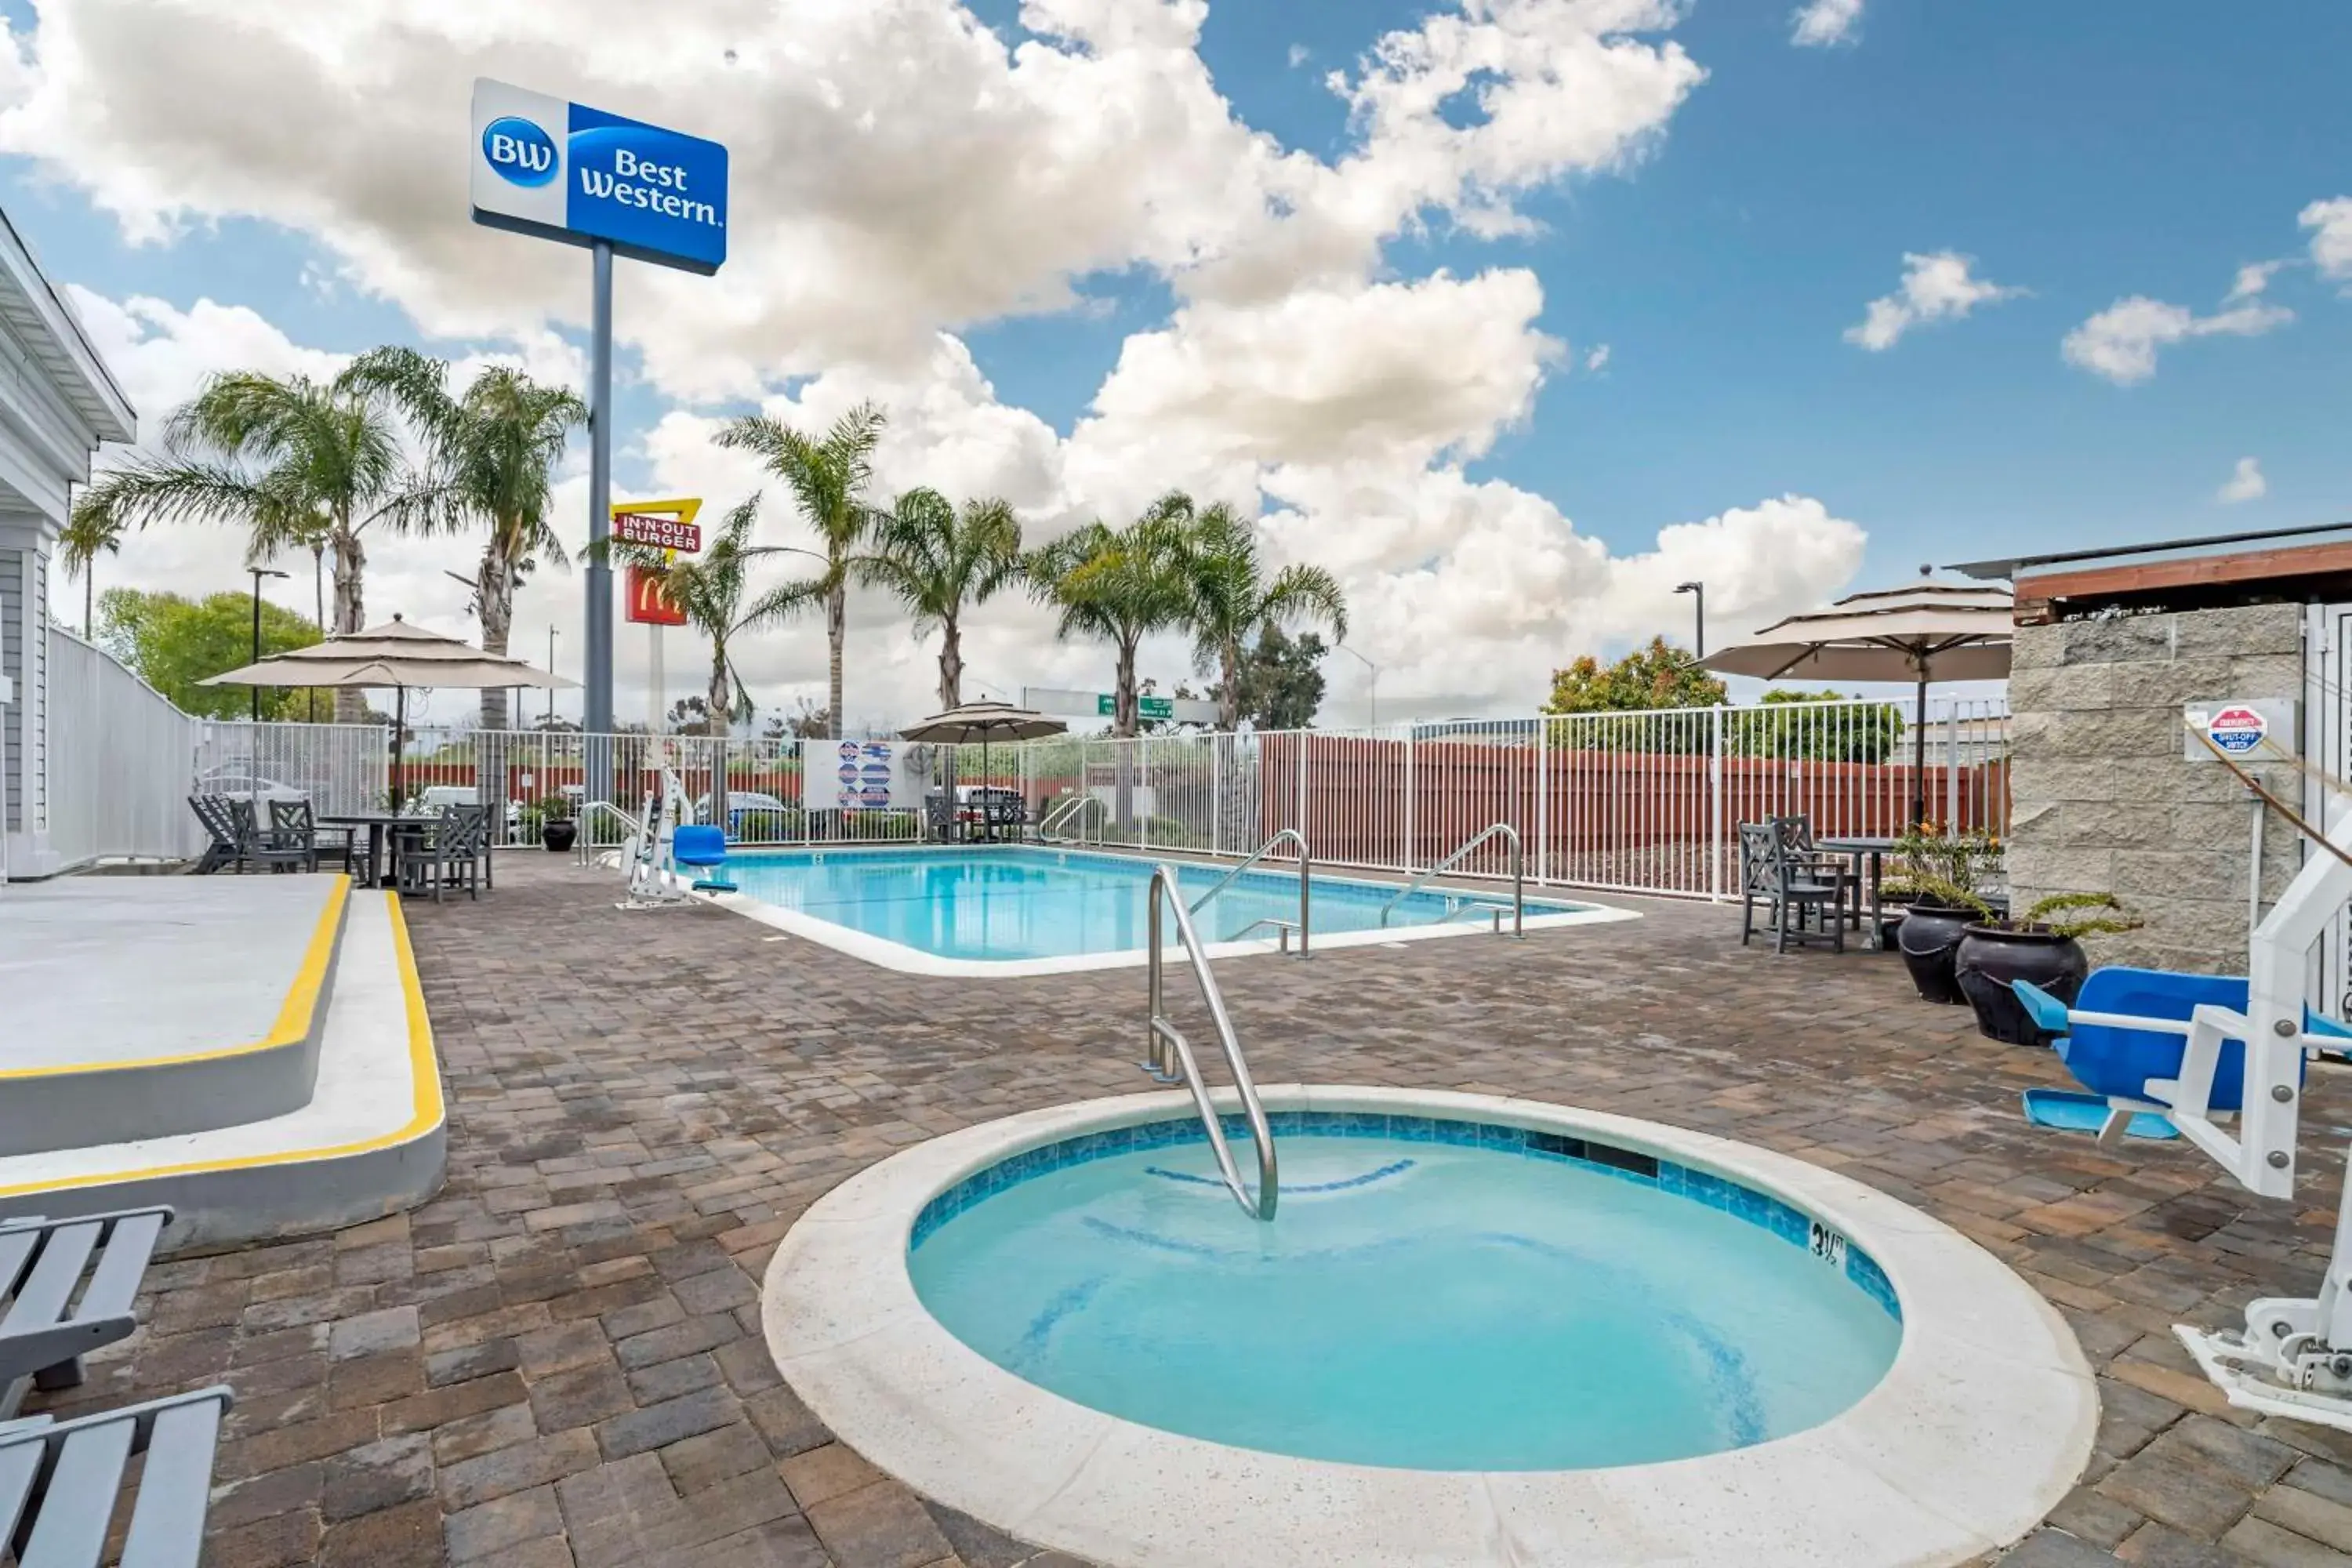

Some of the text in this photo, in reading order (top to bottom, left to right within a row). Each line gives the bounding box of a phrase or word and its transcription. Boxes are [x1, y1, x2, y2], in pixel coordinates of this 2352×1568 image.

[492, 133, 551, 172] BW
[615, 148, 688, 191] Best
[623, 515, 695, 537] IN-N-OUT
[623, 528, 695, 549] BURGER
